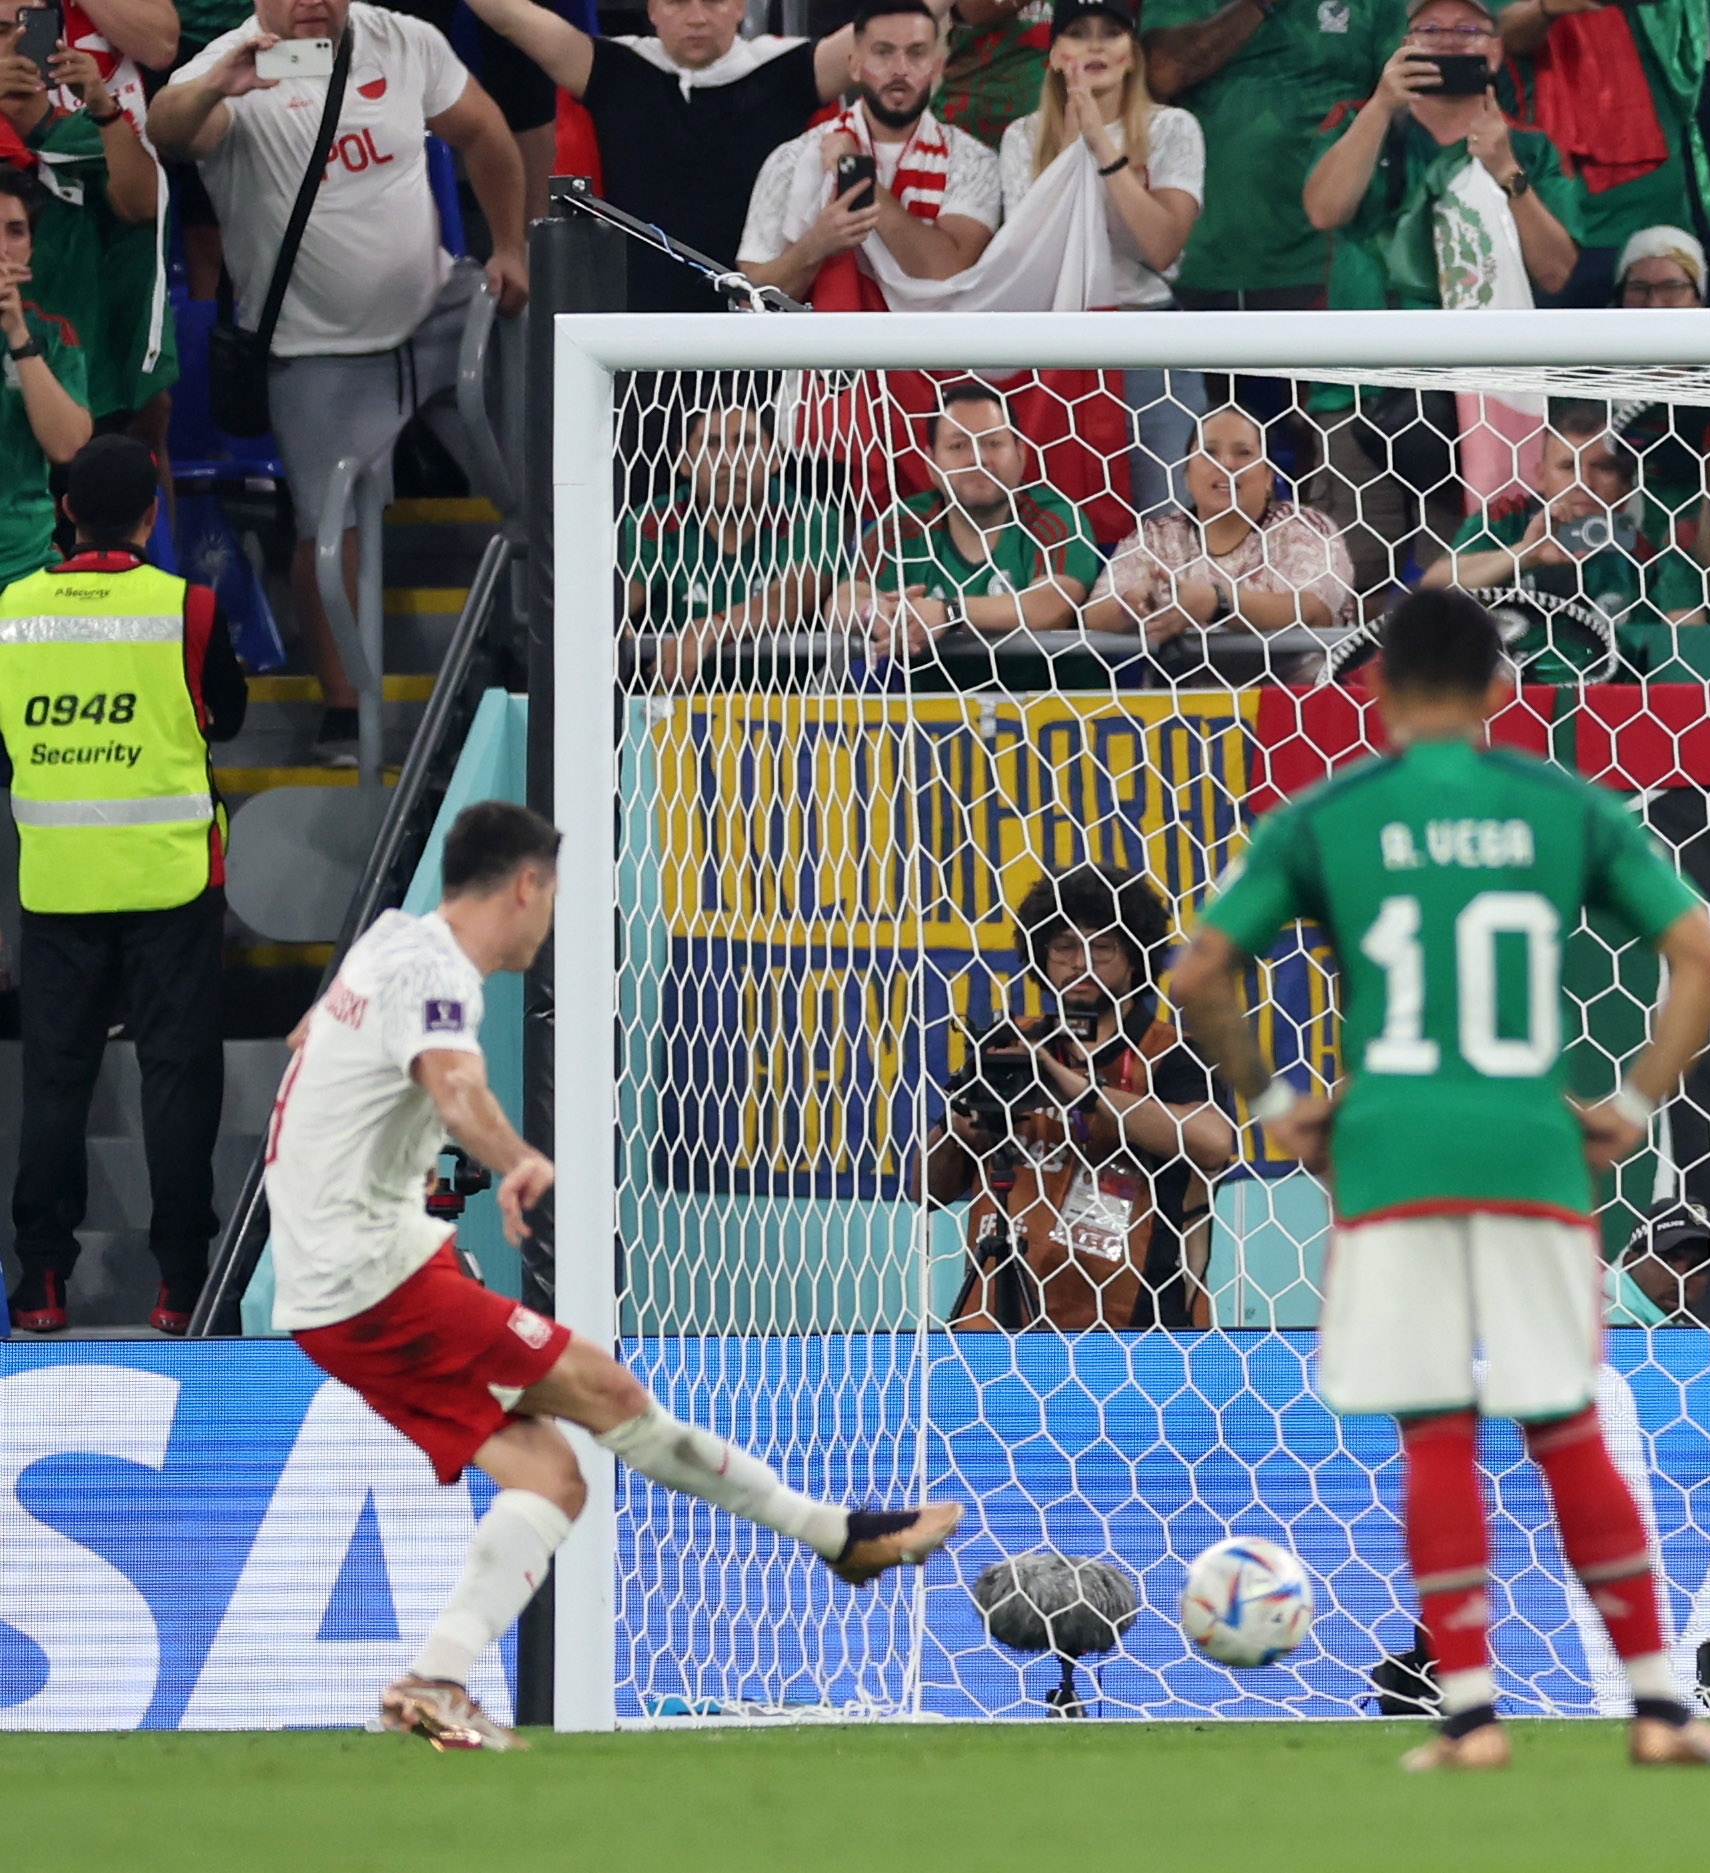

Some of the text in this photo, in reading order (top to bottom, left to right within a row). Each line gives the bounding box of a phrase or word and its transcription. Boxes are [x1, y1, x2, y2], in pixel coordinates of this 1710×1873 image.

[25, 693, 137, 726] 0948
[30, 741, 142, 768] Security
[1360, 890, 1562, 1077] 10
[1657, 1220, 1685, 1231] POLICE
